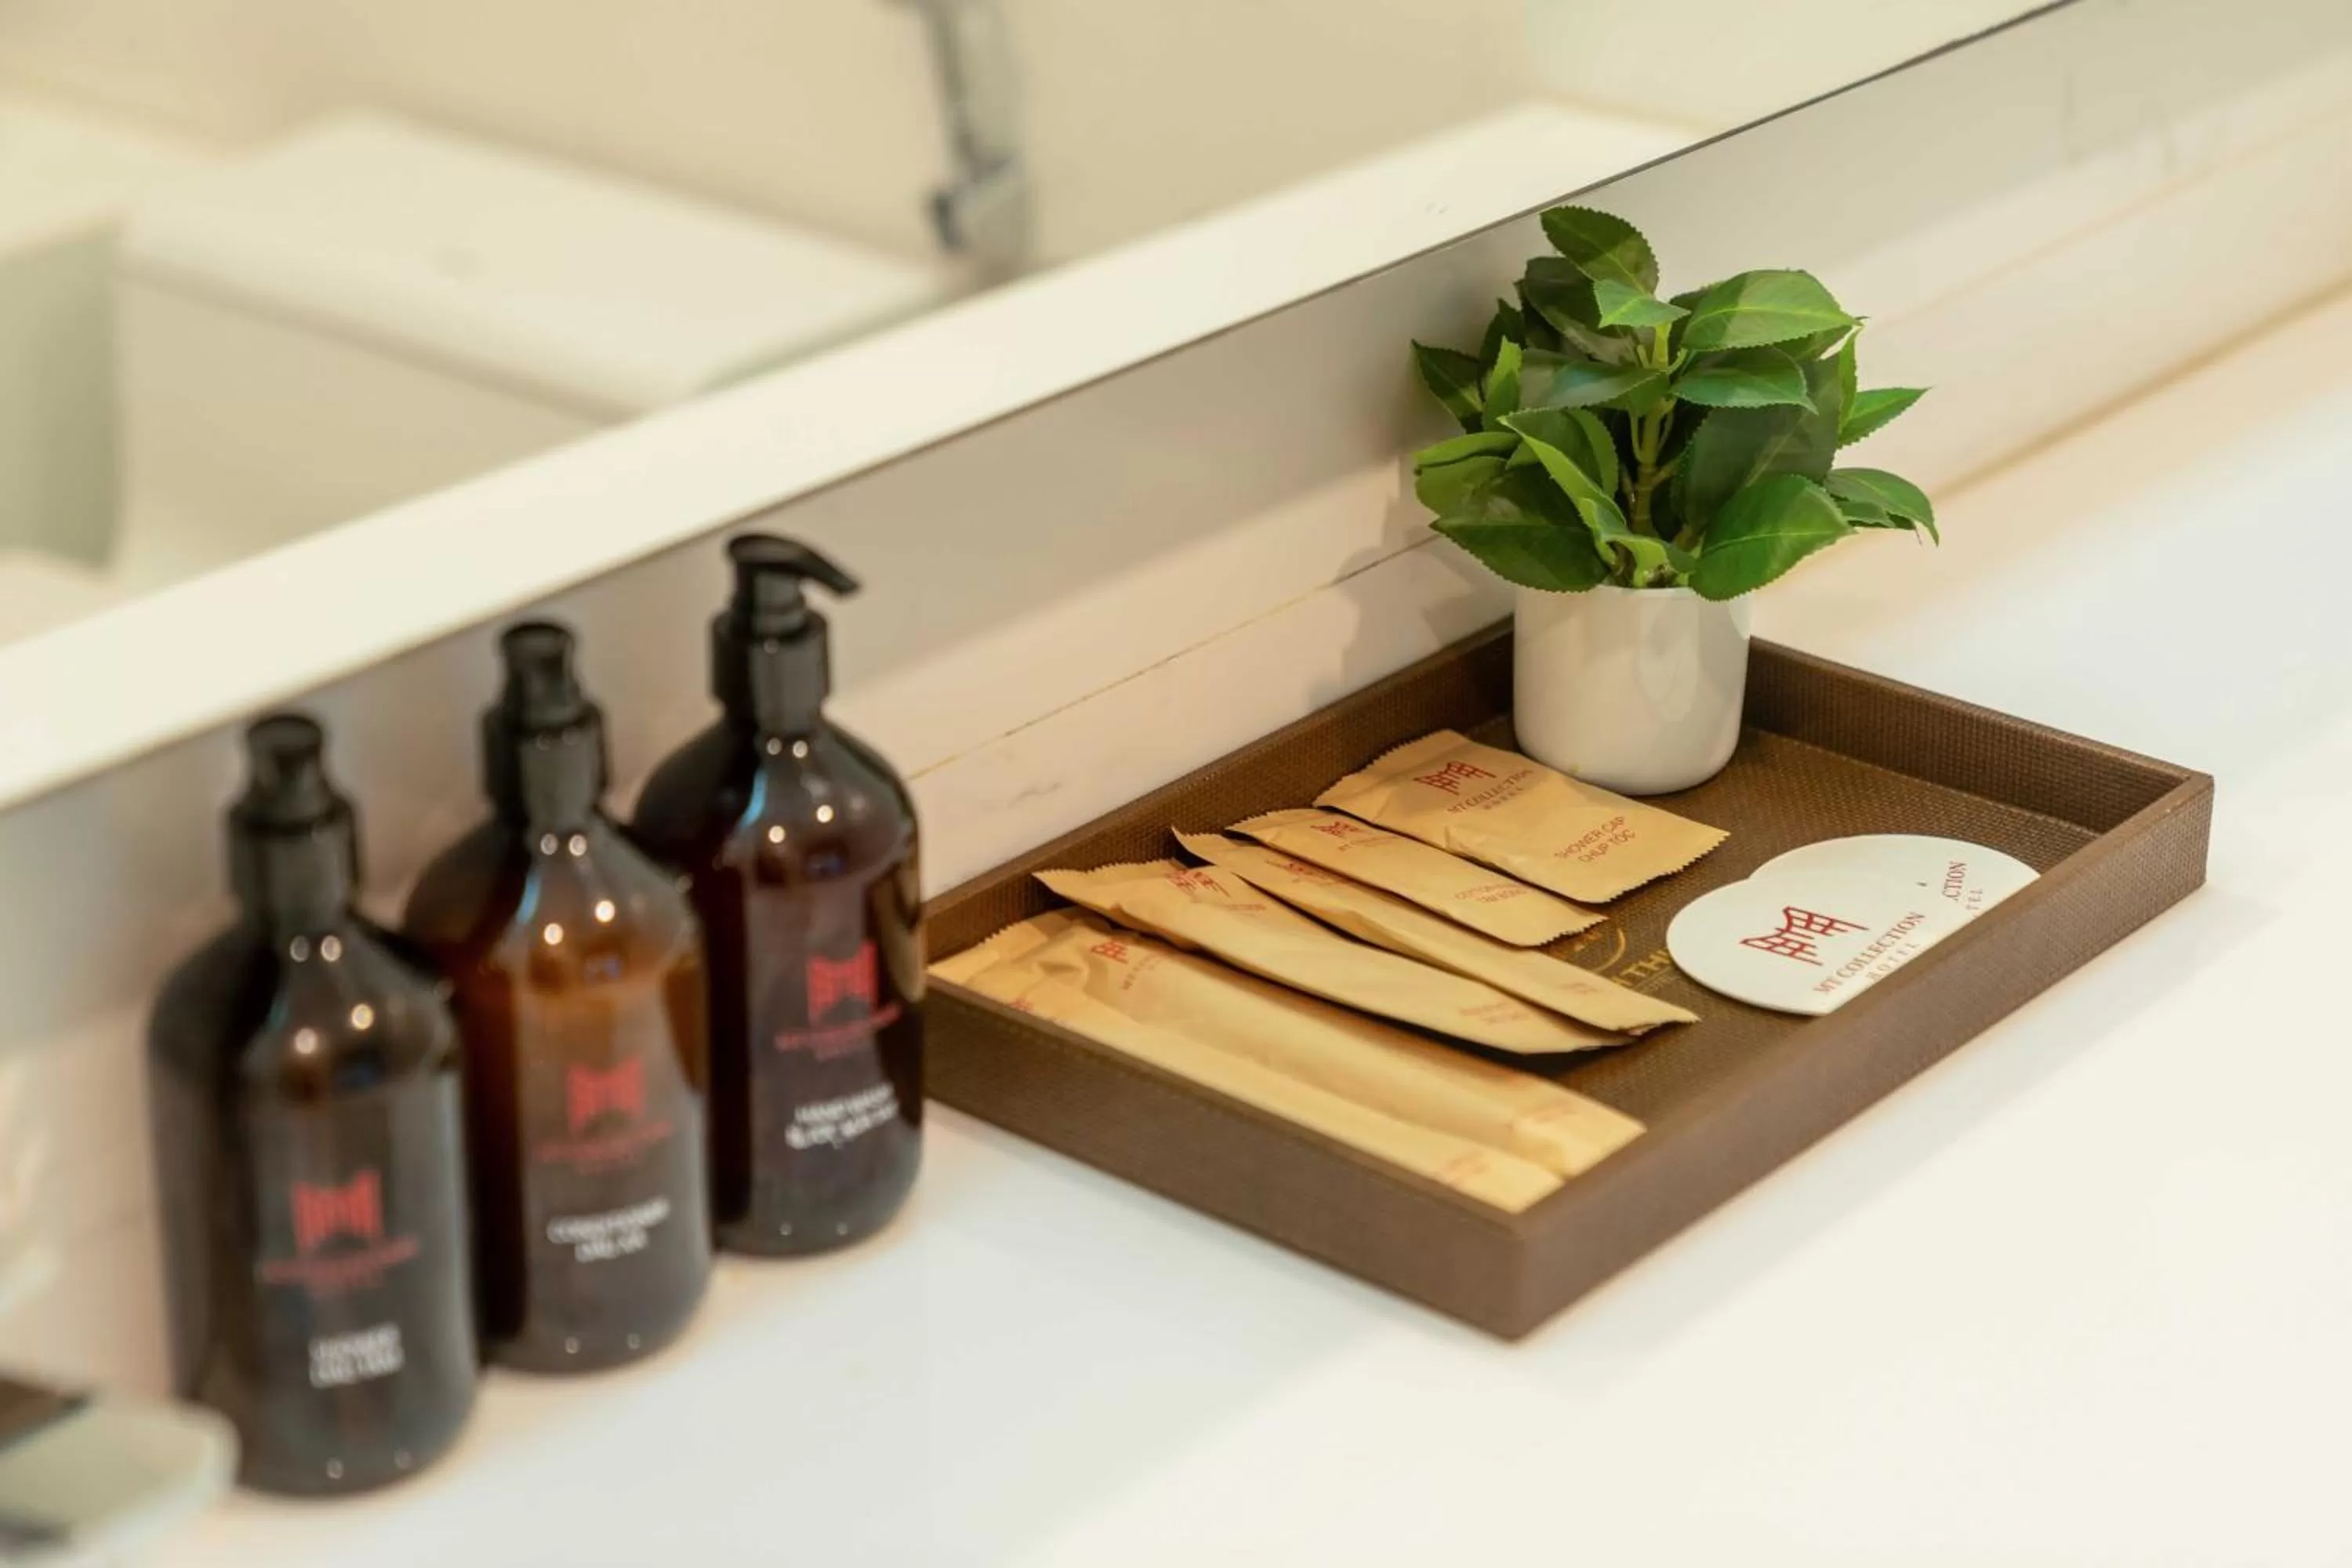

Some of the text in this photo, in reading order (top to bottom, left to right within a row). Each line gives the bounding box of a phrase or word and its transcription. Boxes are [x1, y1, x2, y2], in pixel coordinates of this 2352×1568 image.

[1941, 860, 1968, 904] CTION
[1965, 887, 1984, 910] TEL
[1811, 910, 1926, 994] MT COLLECTION
